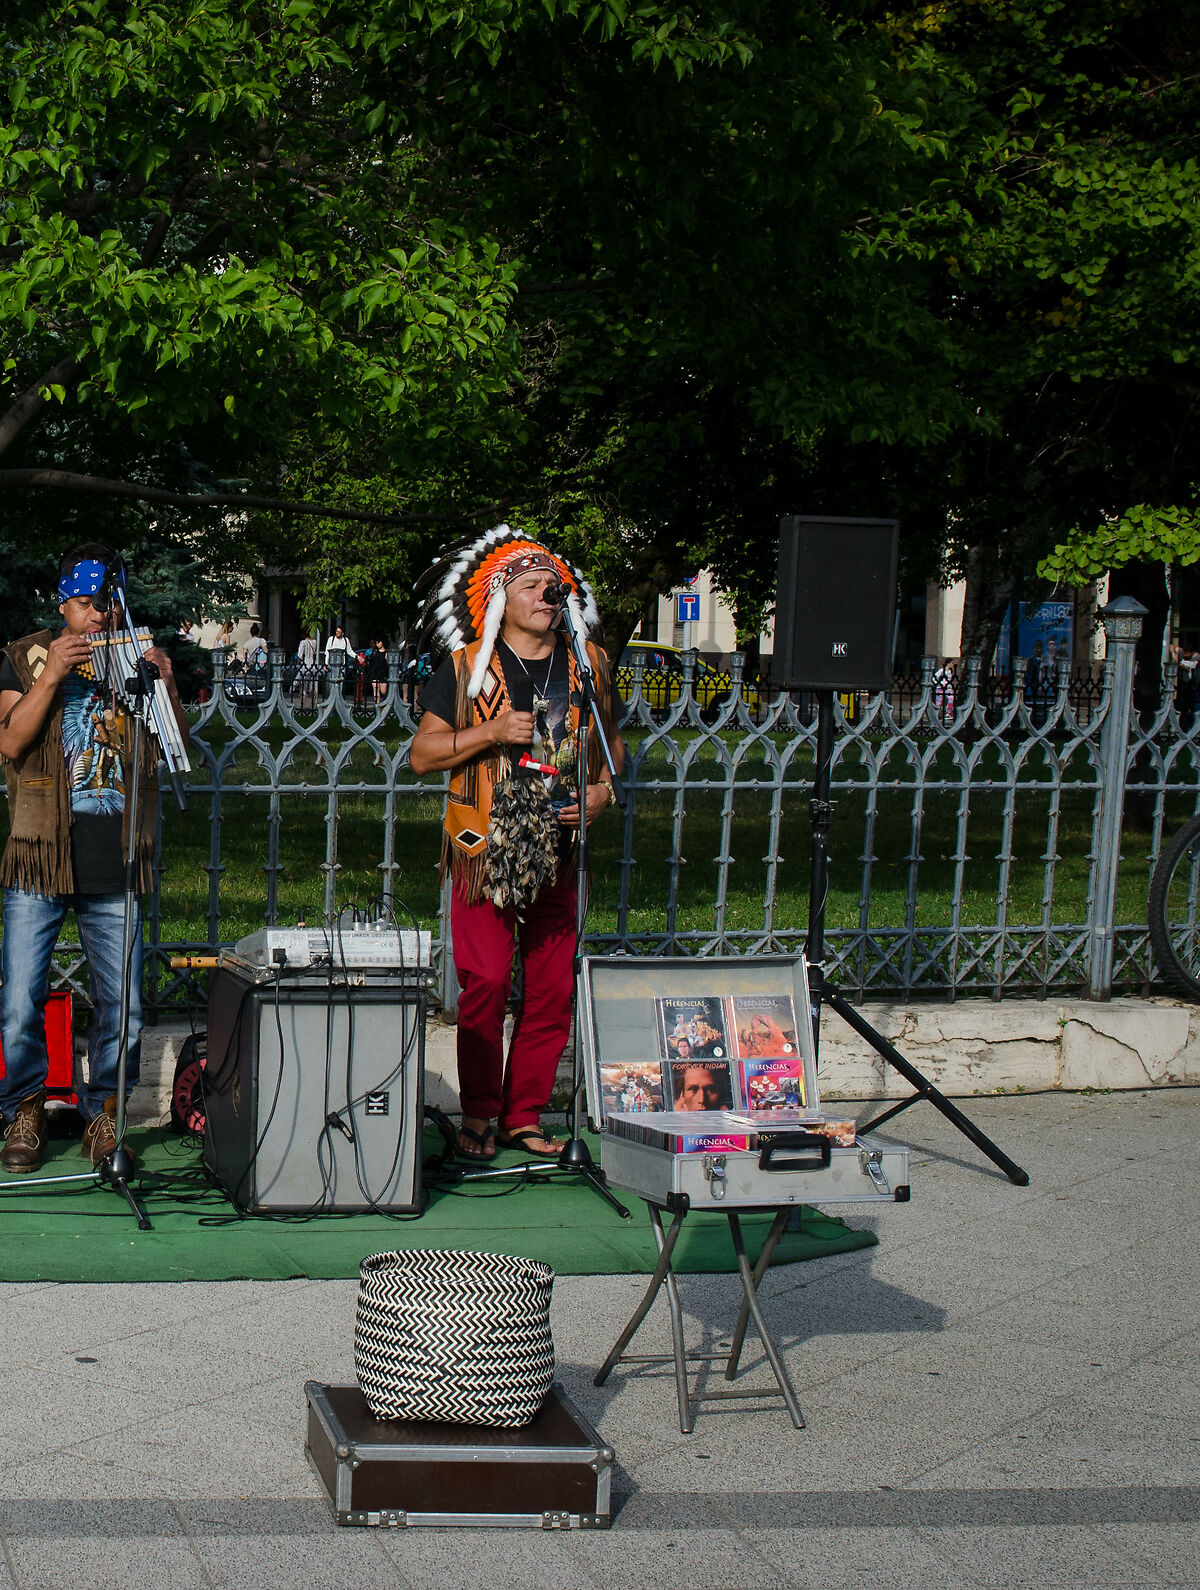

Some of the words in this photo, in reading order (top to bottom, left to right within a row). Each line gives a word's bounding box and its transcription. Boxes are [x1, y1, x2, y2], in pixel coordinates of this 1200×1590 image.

[833, 644, 846, 655] HK
[665, 999, 705, 1008] HERENCIAS
[748, 1063, 787, 1071] HERENCIAS
[688, 1137, 731, 1146] HERENCIAS
